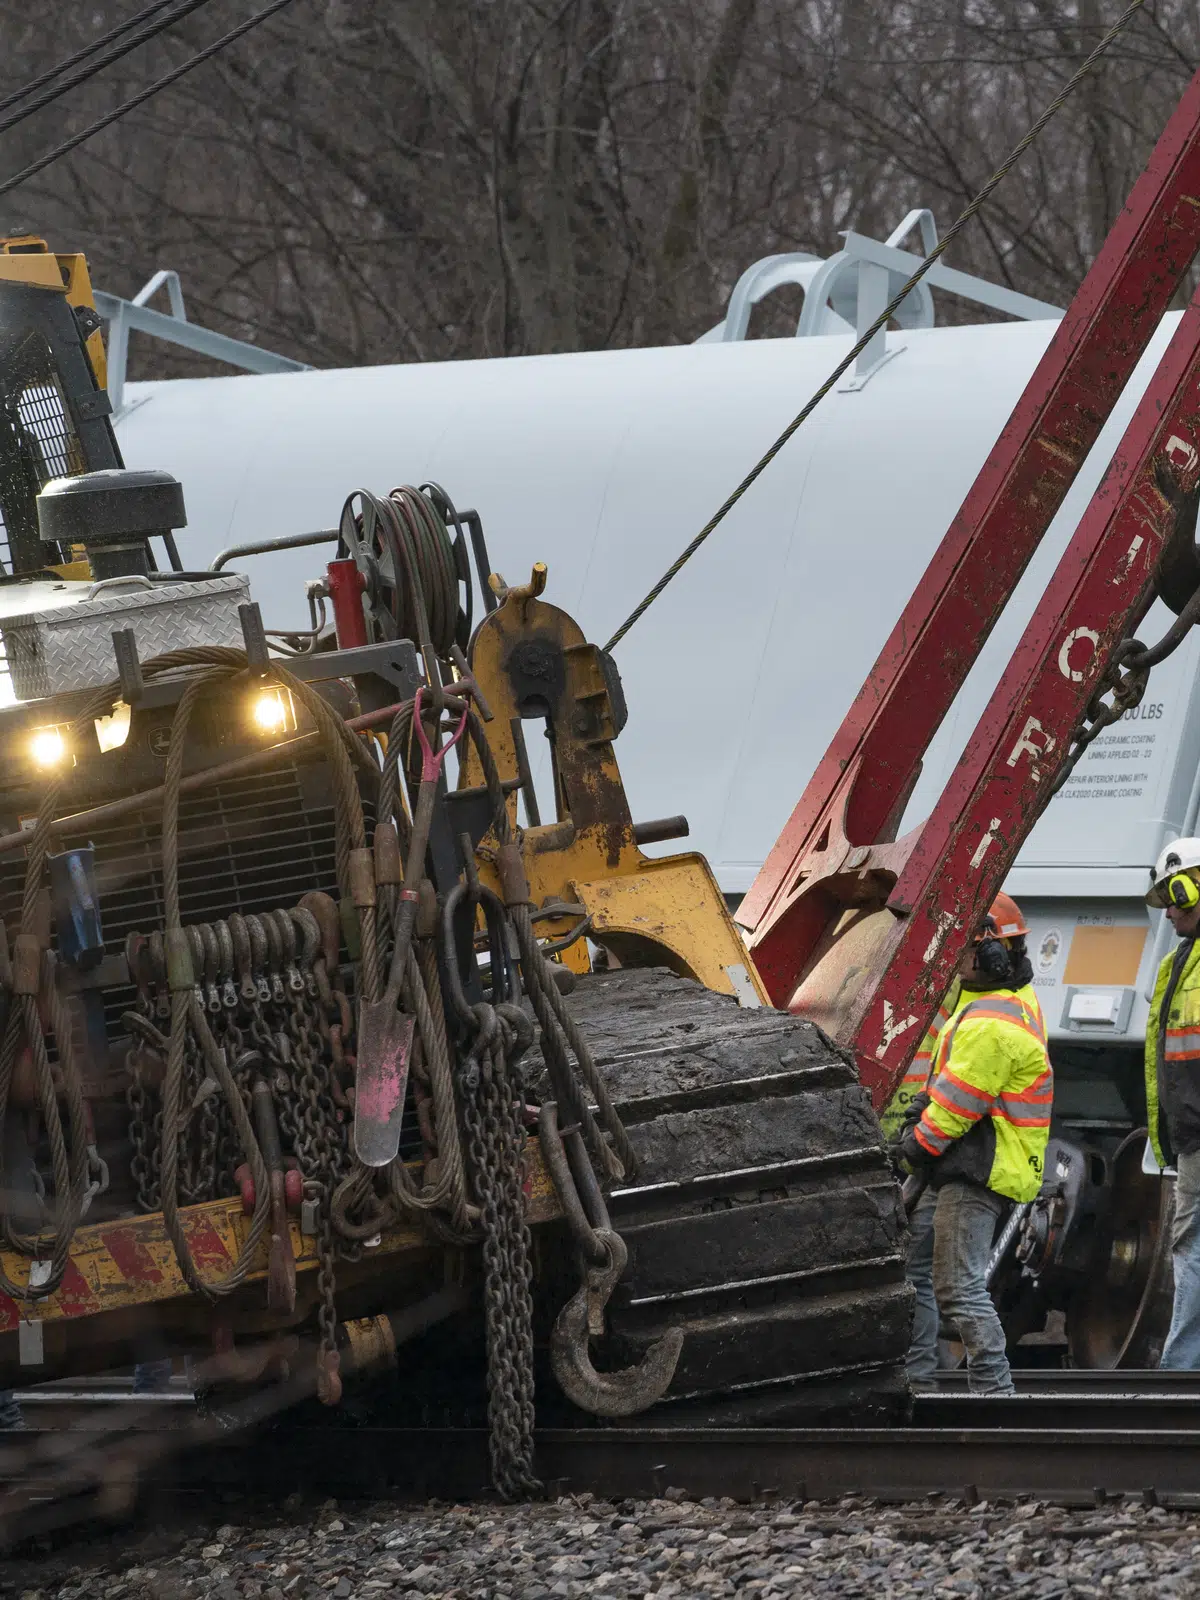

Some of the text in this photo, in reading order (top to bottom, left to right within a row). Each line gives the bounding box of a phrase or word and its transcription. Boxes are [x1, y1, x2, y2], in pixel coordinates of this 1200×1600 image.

[1141, 704, 1164, 720] LBS
[1104, 735, 1131, 745] CERAMIC
[1131, 734, 1156, 744] COATING
[1088, 751, 1107, 760] LINING
[1107, 750, 1131, 760] APPLIED
[1067, 773, 1149, 784] REPAIR INTERIOR LINING WITH
[1091, 789, 1118, 798] CERAMIC
[1118, 788, 1143, 797] COATING
